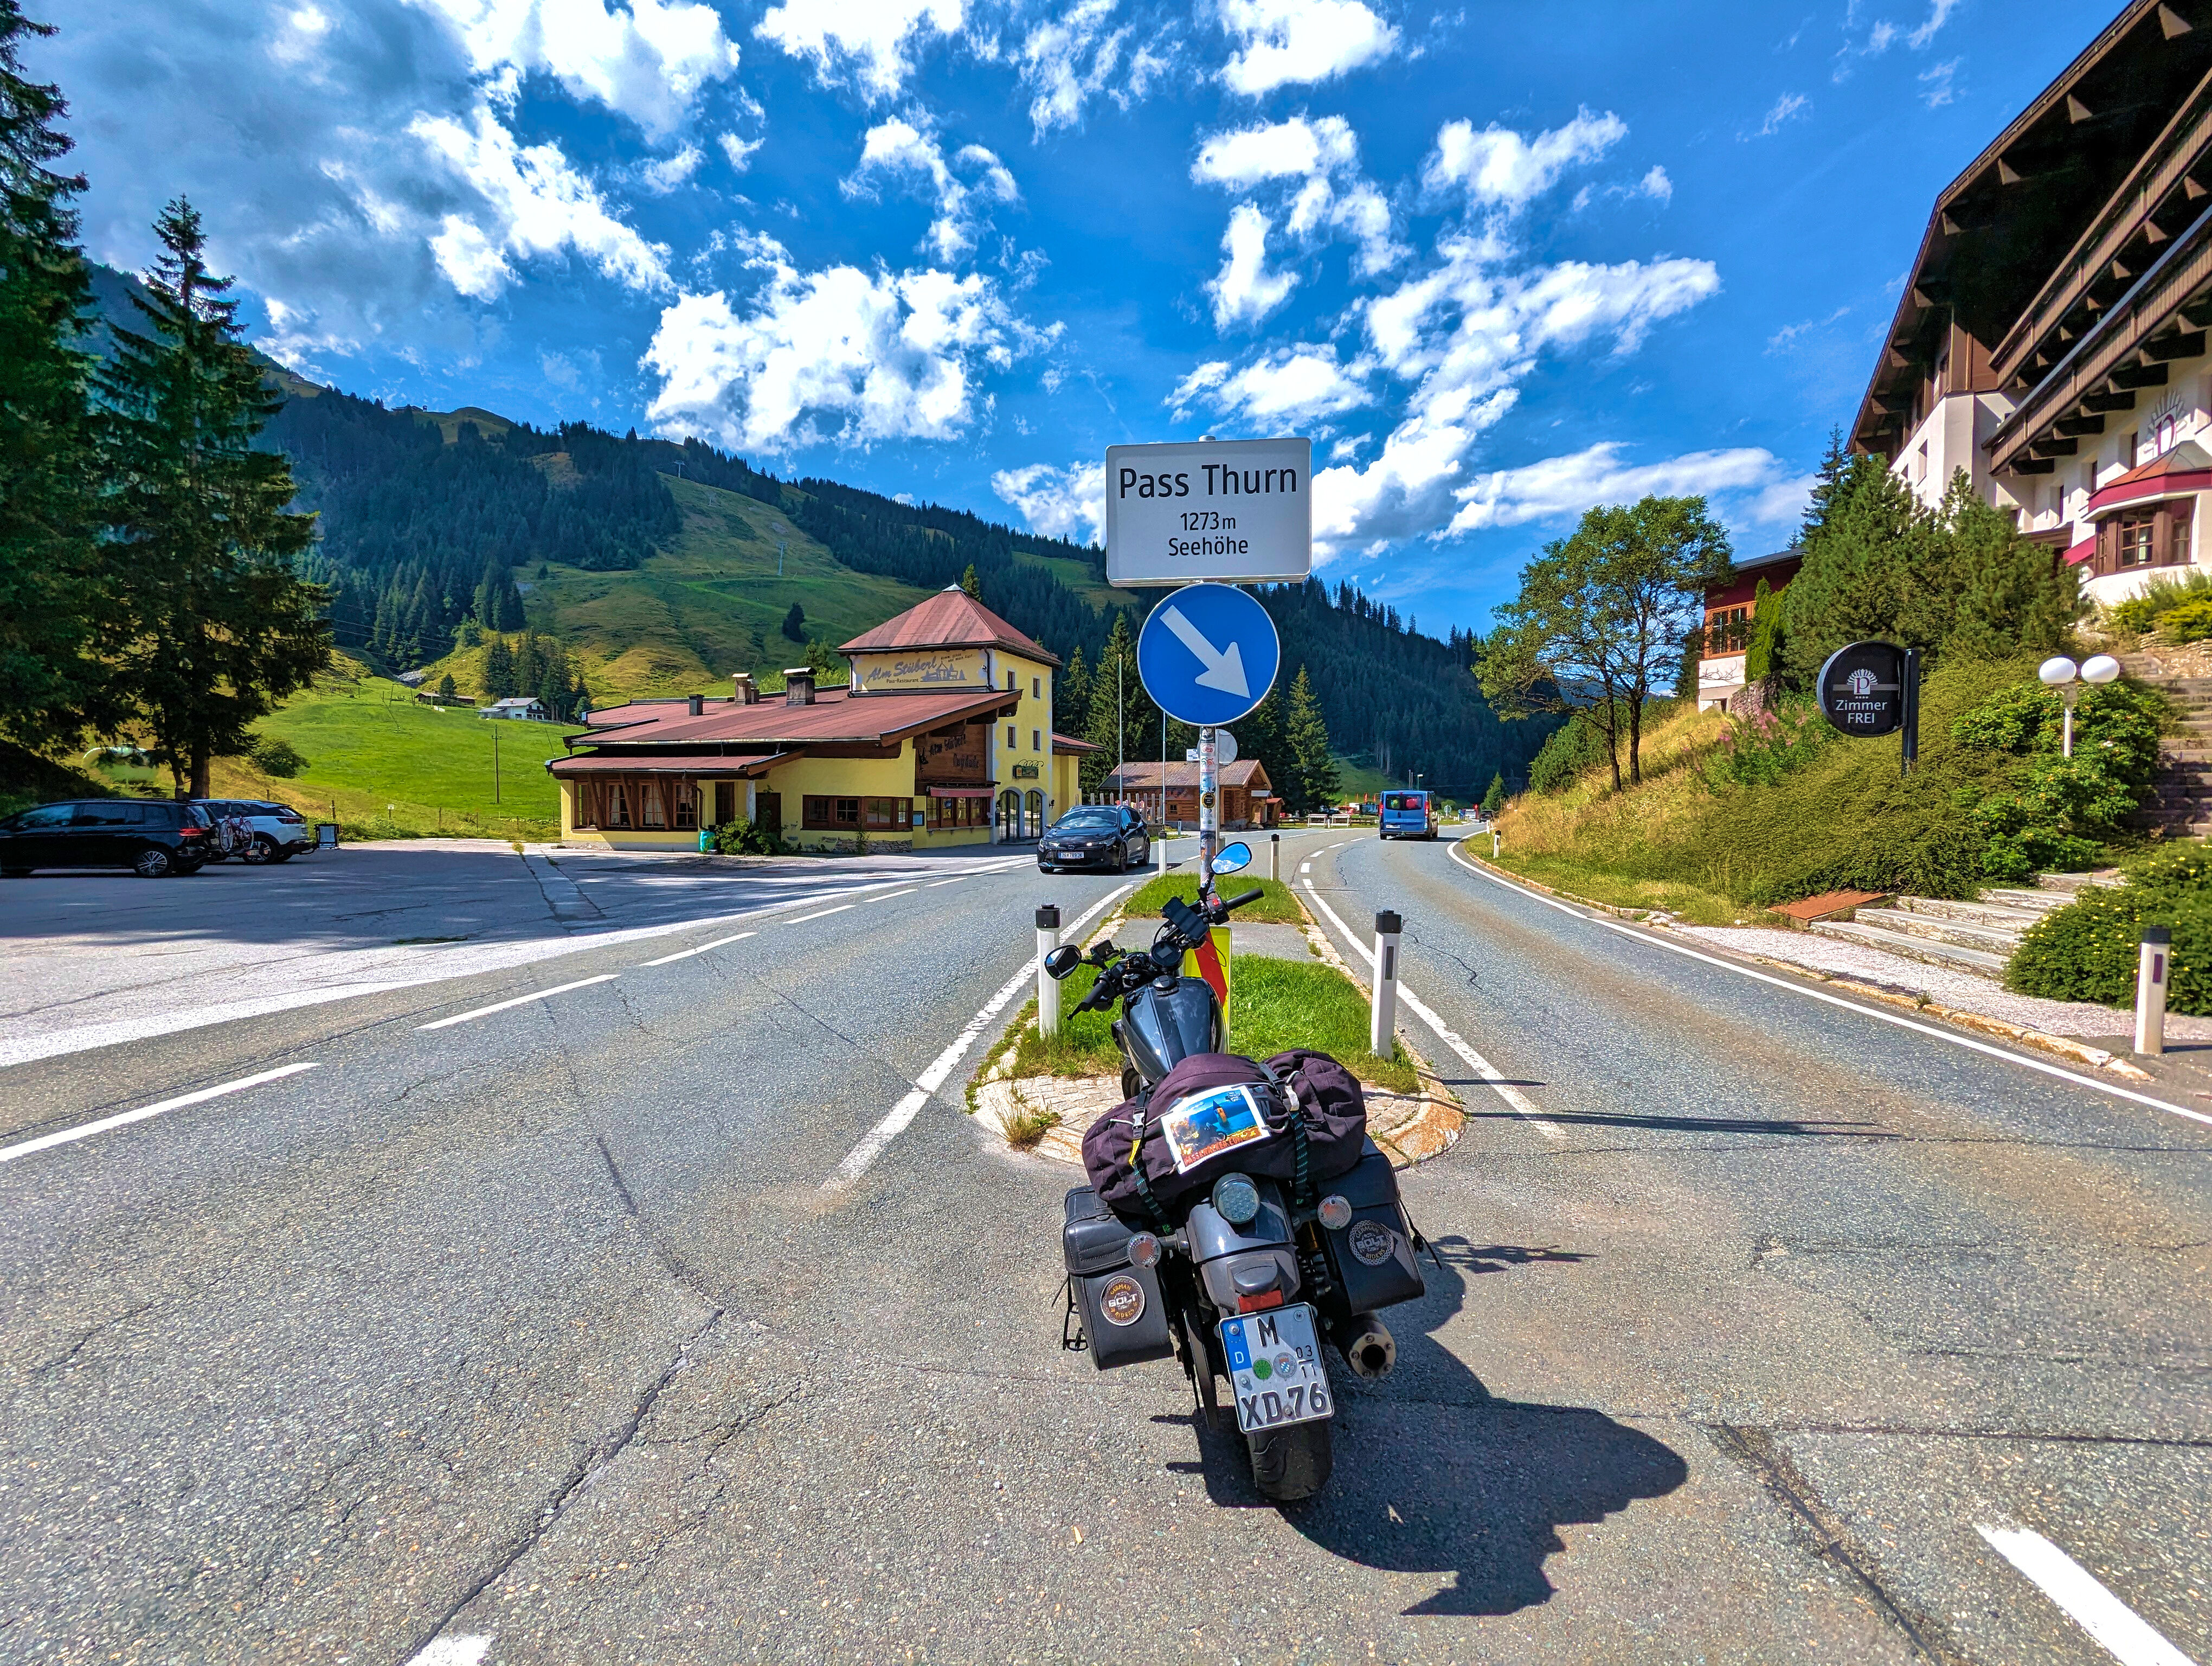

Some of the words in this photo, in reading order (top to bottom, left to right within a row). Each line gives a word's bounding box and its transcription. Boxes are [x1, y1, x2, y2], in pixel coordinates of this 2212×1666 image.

[1120, 467, 1189, 498] Pass
[1201, 464, 1297, 496] Thurn
[1168, 535, 1249, 556] Seehöhe
[866, 667, 892, 683] Alm
[1835, 700, 1888, 710] Zimmer
[1848, 713, 1875, 723] FREI
[1355, 1235, 1384, 1249] BOLT
[1365, 1248, 1385, 1259] RIDERS
[1110, 1284, 1131, 1295] GERMAN
[1108, 1293, 1137, 1308] BOLT
[1257, 1315, 1279, 1348] M
[1234, 1351, 1245, 1364] D
[1295, 1345, 1313, 1359] 03
[1300, 1364, 1317, 1378] 11
[1241, 1391, 1283, 1428] XD
[1287, 1382, 1327, 1418] 76
